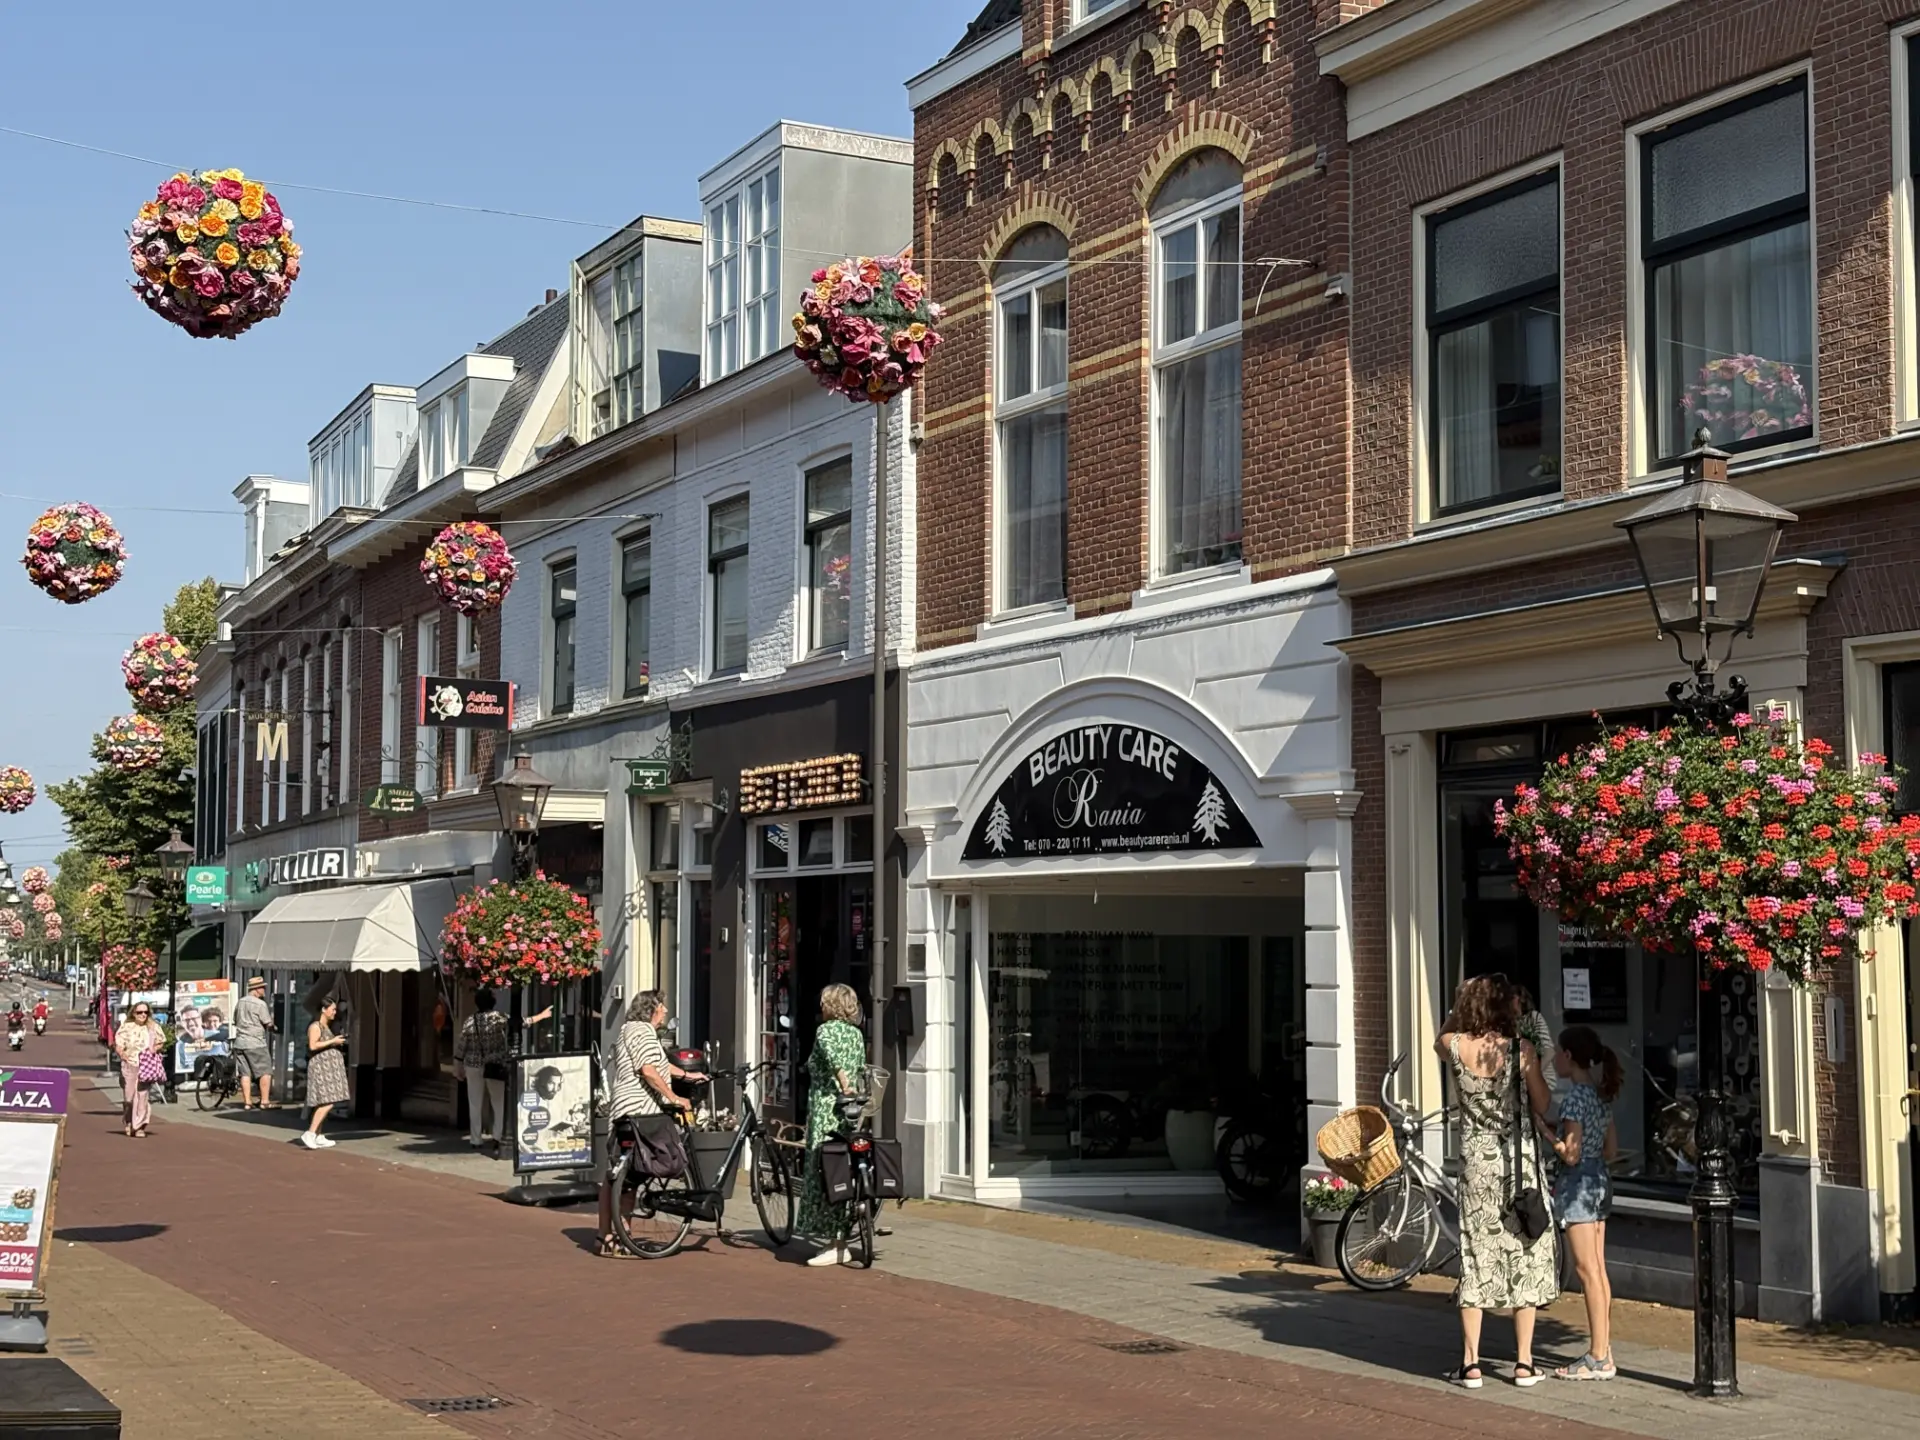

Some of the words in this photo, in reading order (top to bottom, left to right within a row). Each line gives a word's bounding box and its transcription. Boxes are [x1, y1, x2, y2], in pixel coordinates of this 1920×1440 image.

[467, 691, 497, 703] Asian
[466, 702, 504, 715] Cuisine
[256, 722, 289, 761] M
[1029, 726, 1113, 787] BEAUTY
[1118, 728, 1179, 782] CARE
[1053, 768, 1147, 829] Rania
[1024, 839, 1037, 851] Tel:
[1038, 838, 1051, 850] 070
[1057, 837, 1070, 849] 220
[1072, 837, 1080, 848] 17
[1082, 836, 1091, 848] 11
[1101, 832, 1190, 849] www.beautycarerania.nl
[189, 884, 222, 895] Pearle
[0, 1251, 34, 1266] 20%
